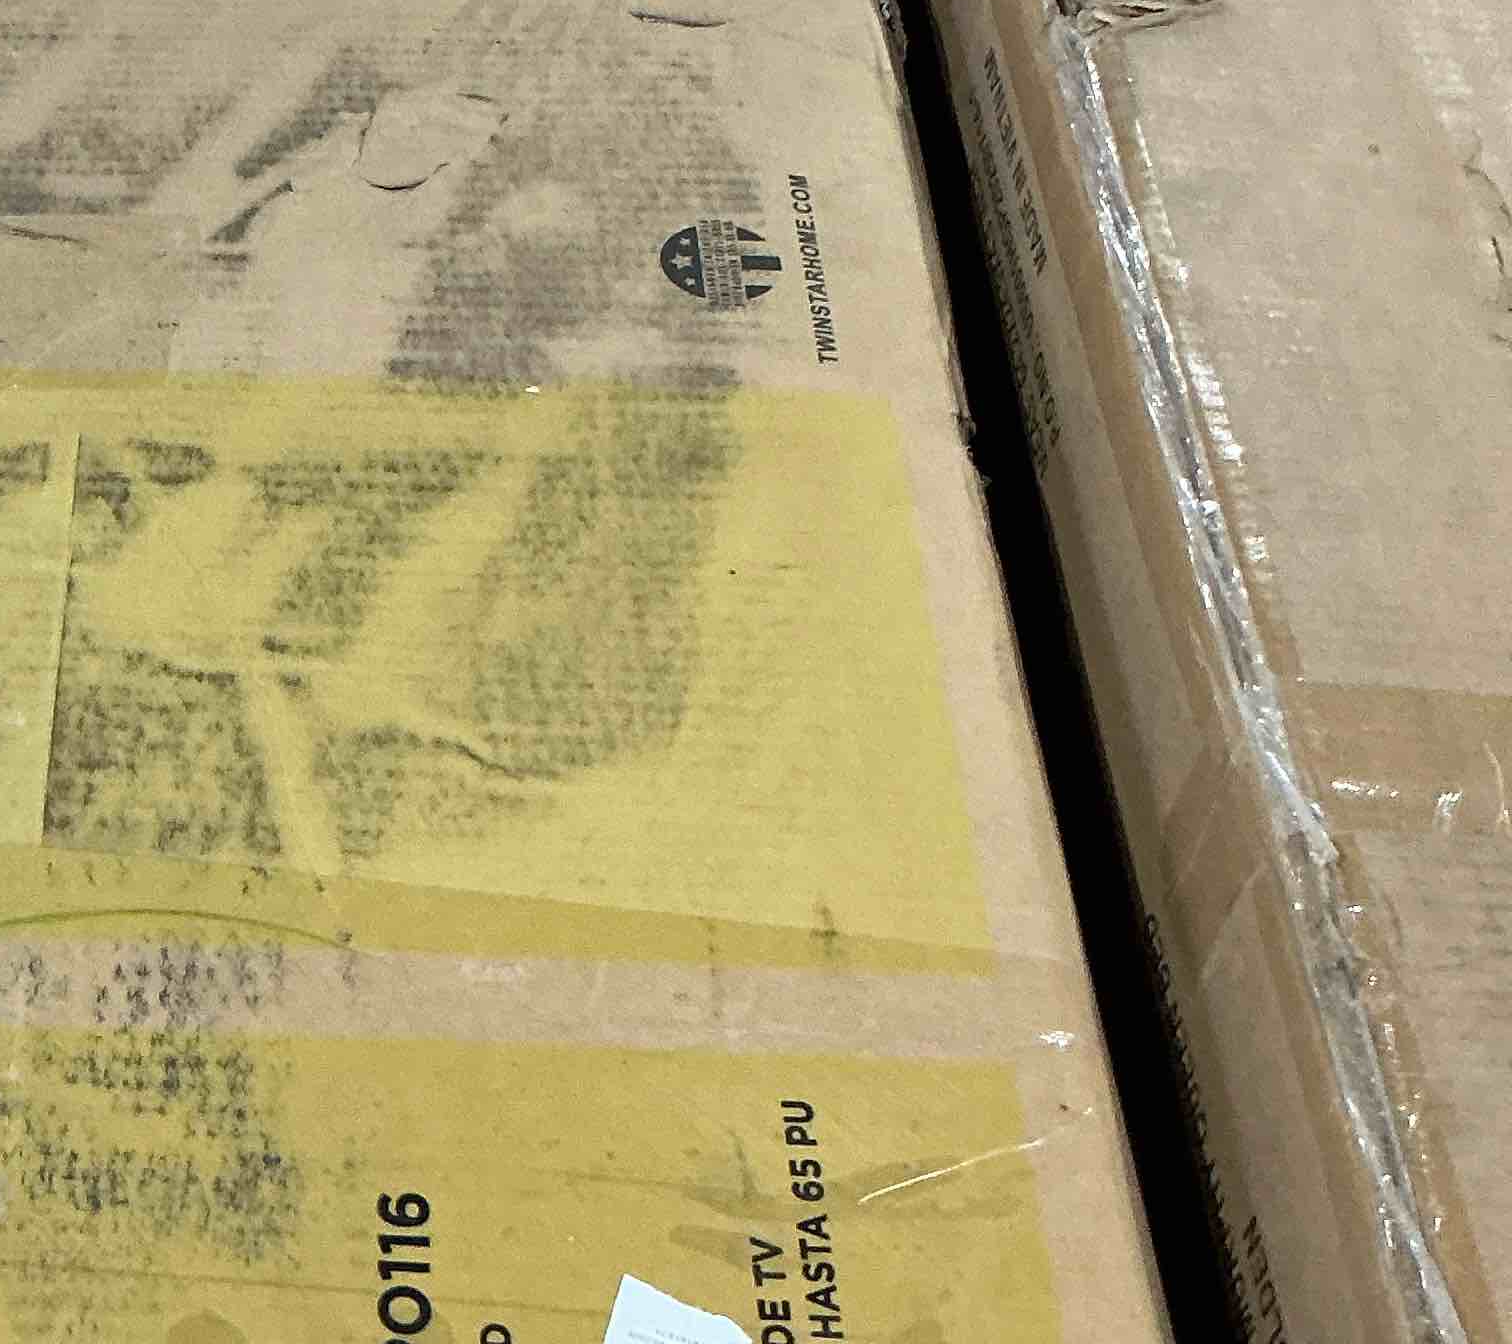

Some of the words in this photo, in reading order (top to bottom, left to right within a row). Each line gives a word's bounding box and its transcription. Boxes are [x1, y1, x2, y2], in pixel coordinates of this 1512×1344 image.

[789, 174, 839, 364] TWINSTARHOME.COM
[781, 1100, 818, 1146] PU
[789, 1159, 824, 1202] 65
[750, 1236, 786, 1287] TV
[796, 1213, 843, 1339] HASTA
